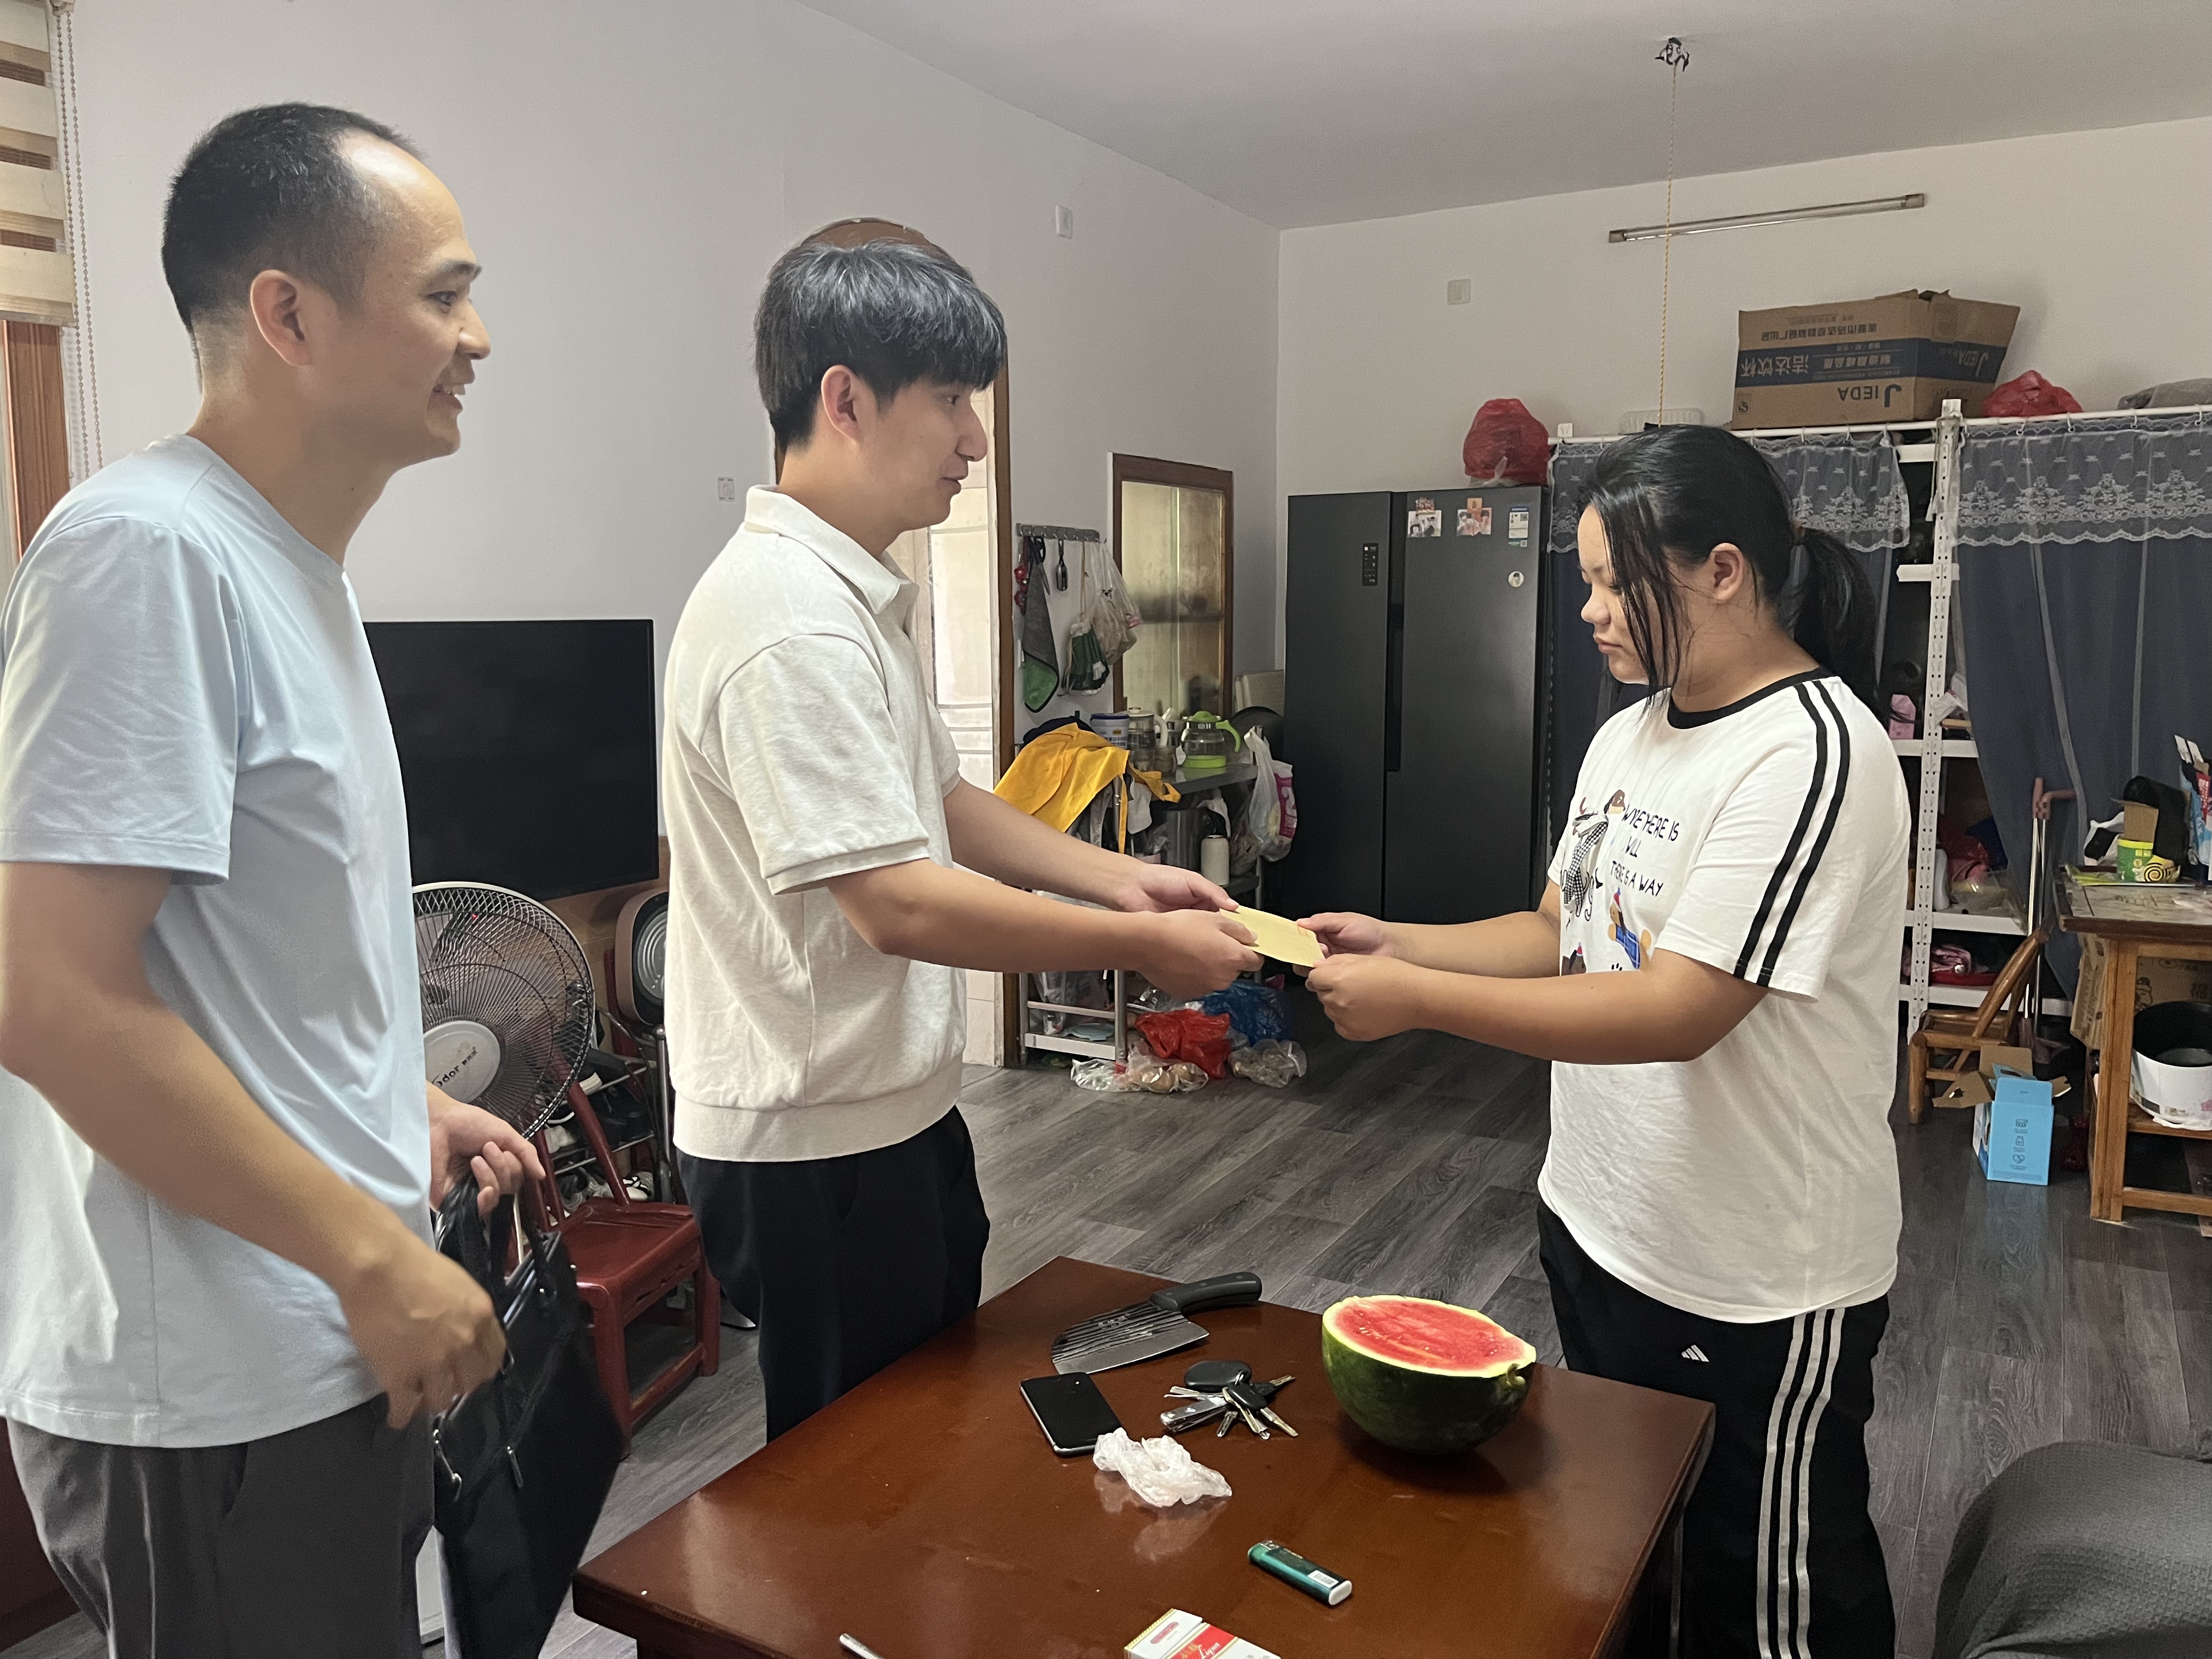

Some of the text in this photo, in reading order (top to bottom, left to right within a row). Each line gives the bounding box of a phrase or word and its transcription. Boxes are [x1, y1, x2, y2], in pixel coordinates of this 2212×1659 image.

[1740, 354, 1809, 377] 洁达饮杯
[1837, 383, 1903, 408] JIEDA
[1668, 820, 1679, 842] IS
[1628, 872, 1637, 889] A
[1639, 874, 1664, 897] WAY
